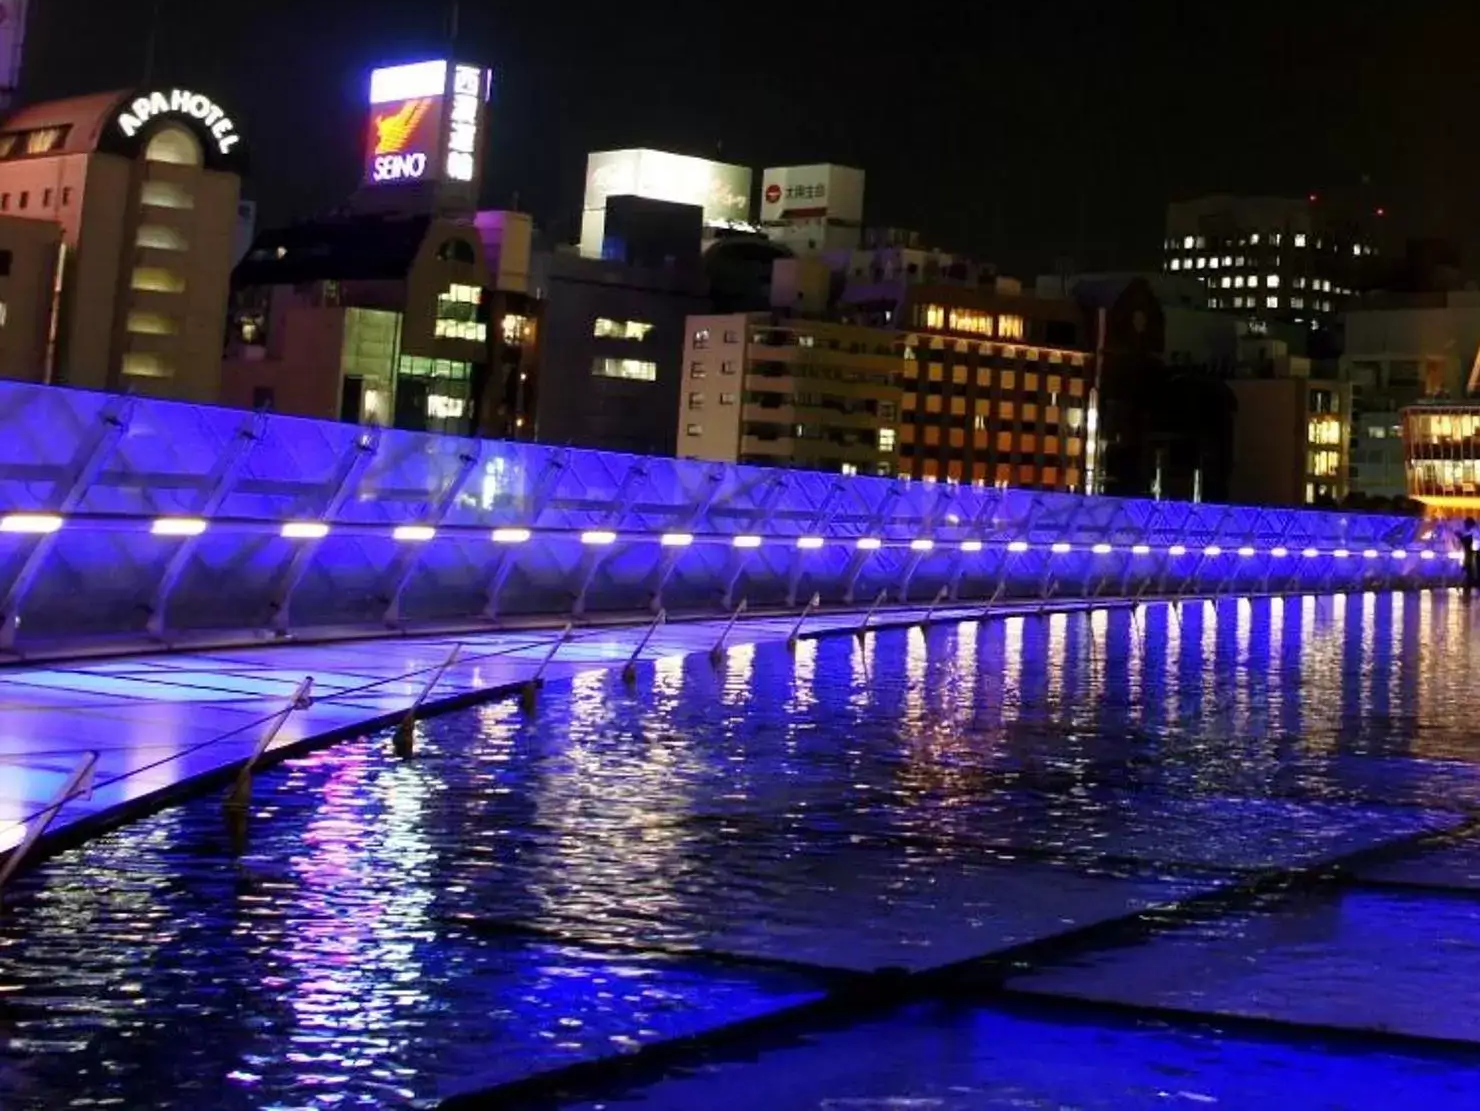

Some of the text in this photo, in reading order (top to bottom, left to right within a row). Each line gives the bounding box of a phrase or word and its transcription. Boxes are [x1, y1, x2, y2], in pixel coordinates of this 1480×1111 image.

[117, 88, 239, 154] APA HOTEL
[373, 153, 427, 181] SEINO
